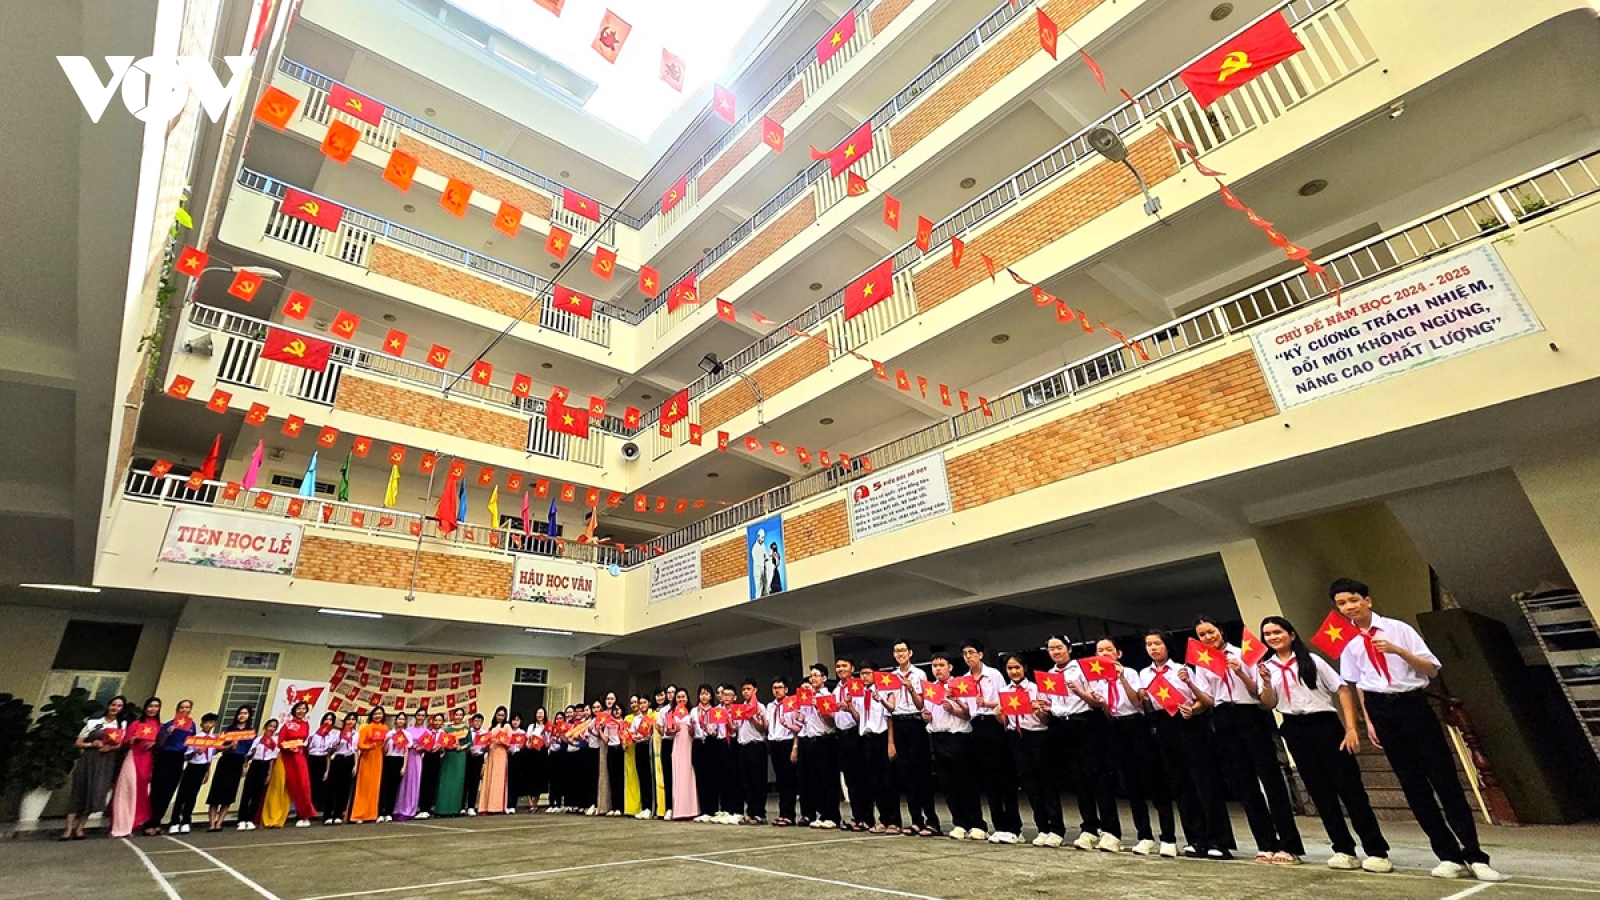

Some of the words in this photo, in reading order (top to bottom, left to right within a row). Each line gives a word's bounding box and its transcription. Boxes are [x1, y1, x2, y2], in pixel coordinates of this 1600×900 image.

[1276, 326, 1301, 344] CHỦ
[1325, 308, 1358, 326] NĂM
[1360, 295, 1392, 313] HỌC
[1394, 282, 1427, 300] 2024
[1436, 265, 1470, 285] 2025
[1308, 326, 1360, 351] CƯƠNG
[1362, 304, 1420, 331] TRÁCH
[1425, 280, 1494, 309] NHIỆM,
[1292, 356, 1319, 376] ĐỔI
[1322, 348, 1353, 365] MỚI
[1357, 326, 1417, 354] KHÔNG
[1420, 303, 1490, 332] NGỪNG,
[1296, 373, 1339, 394] NÂNG
[1341, 361, 1374, 378] CAO
[1378, 342, 1422, 366] CHẤT
[177, 524, 223, 545] TIÊN
[224, 532, 266, 553] HỌC
[268, 533, 292, 554] LỄ
[546, 574, 569, 591] HỌC
[572, 576, 592, 592] VĂN
